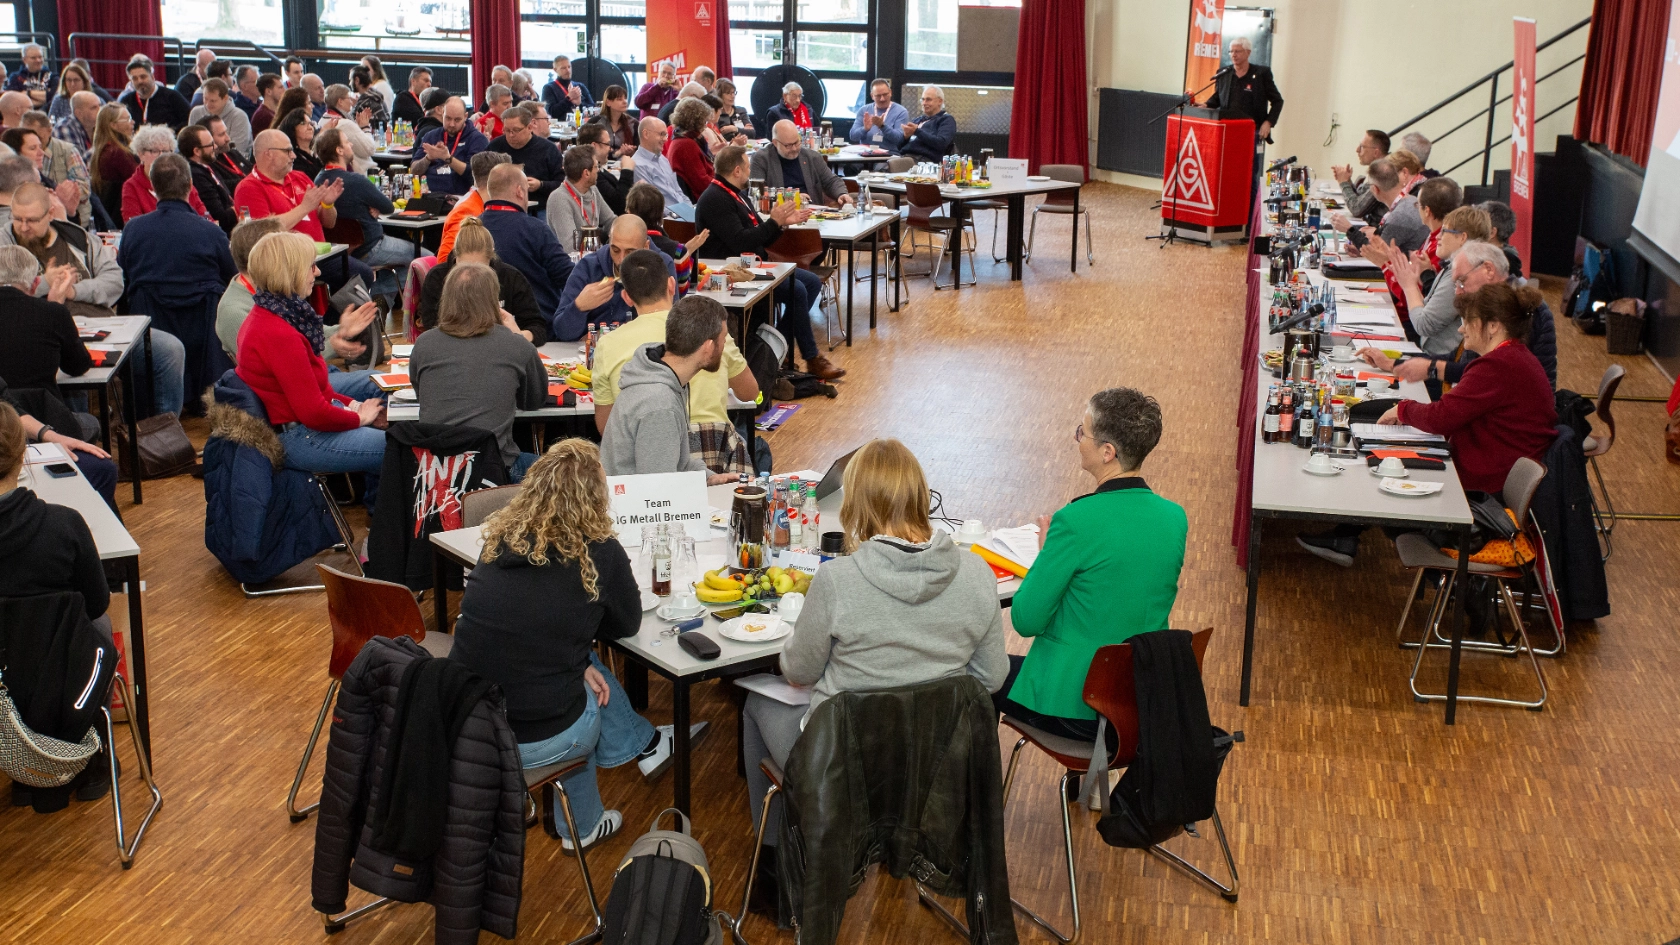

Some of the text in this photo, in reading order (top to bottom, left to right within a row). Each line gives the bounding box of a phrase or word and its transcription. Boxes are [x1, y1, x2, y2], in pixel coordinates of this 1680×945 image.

[652, 52, 686, 73] TM
[644, 499, 671, 509] Team
[616, 512, 701, 525] IG Metall Bremen
